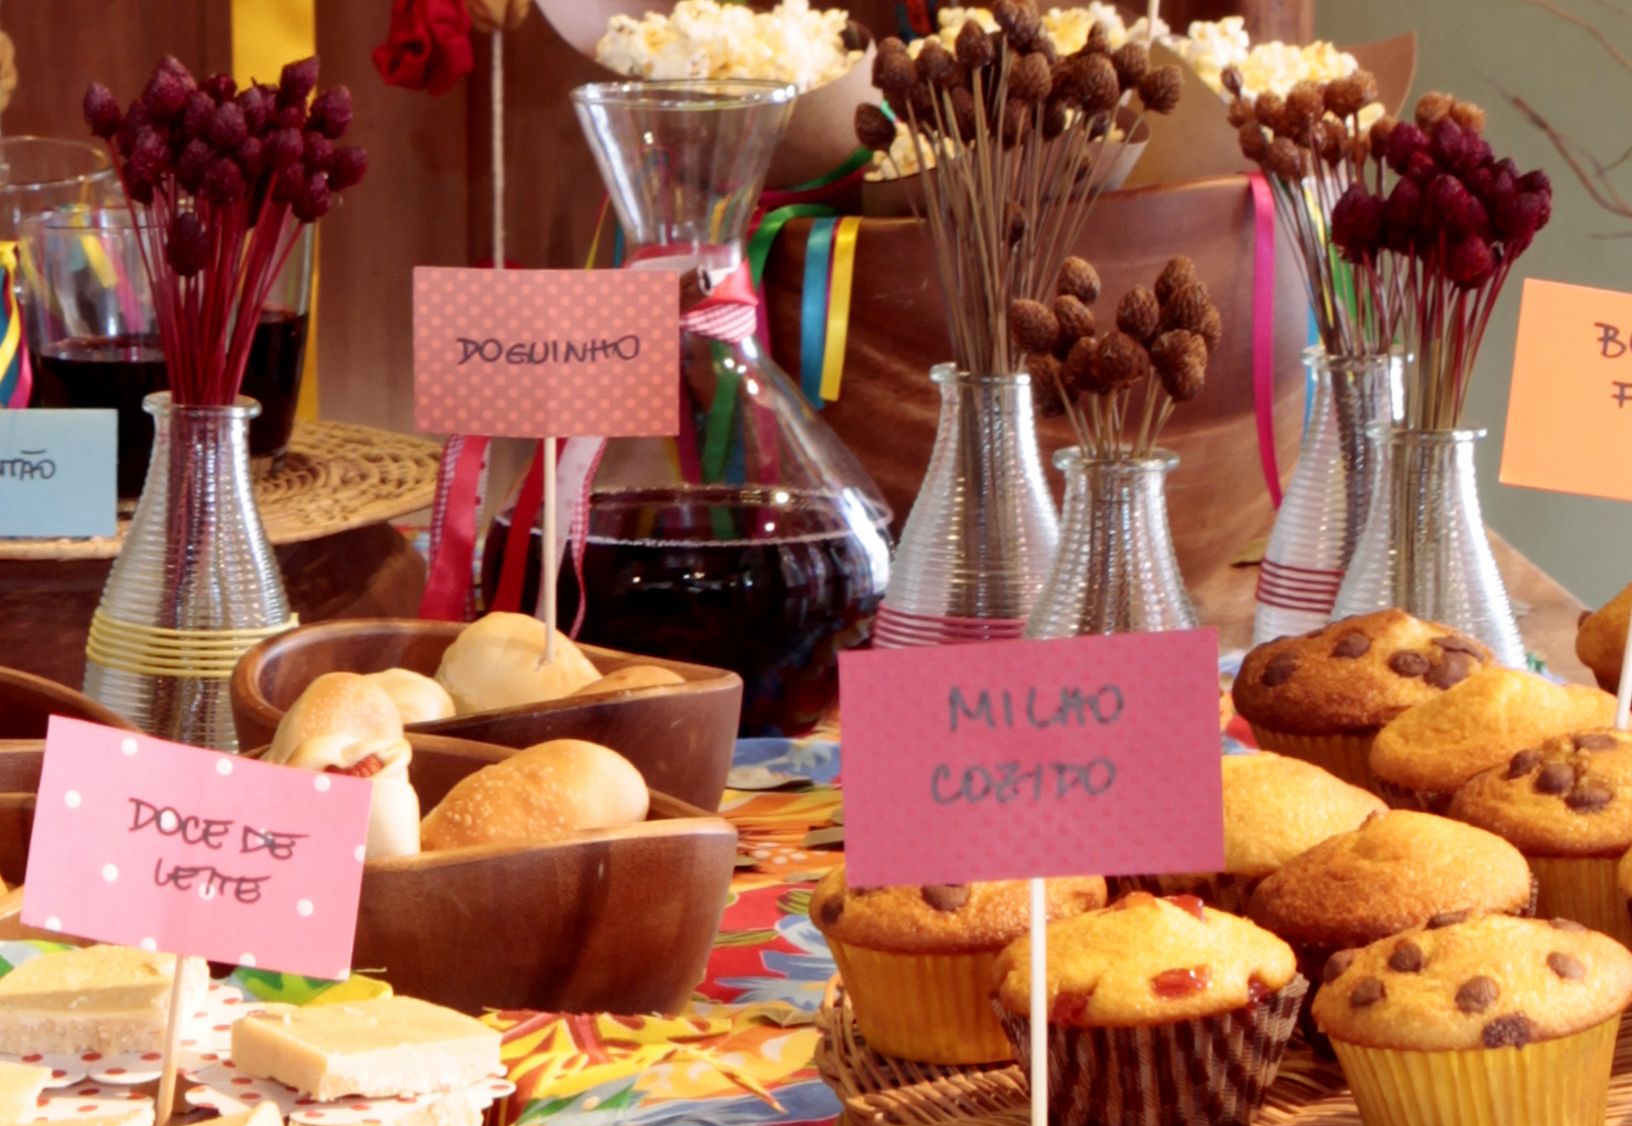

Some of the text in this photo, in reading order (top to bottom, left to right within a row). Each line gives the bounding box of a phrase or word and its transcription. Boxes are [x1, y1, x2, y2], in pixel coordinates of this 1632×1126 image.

[457, 334, 640, 365] DOGUINHO
[1594, 322, 1632, 359] B
[948, 684, 1125, 731] MILHO
[931, 757, 1117, 805] COZIDO
[128, 798, 310, 860] DOCE DE
[154, 858, 272, 904] LEITE
